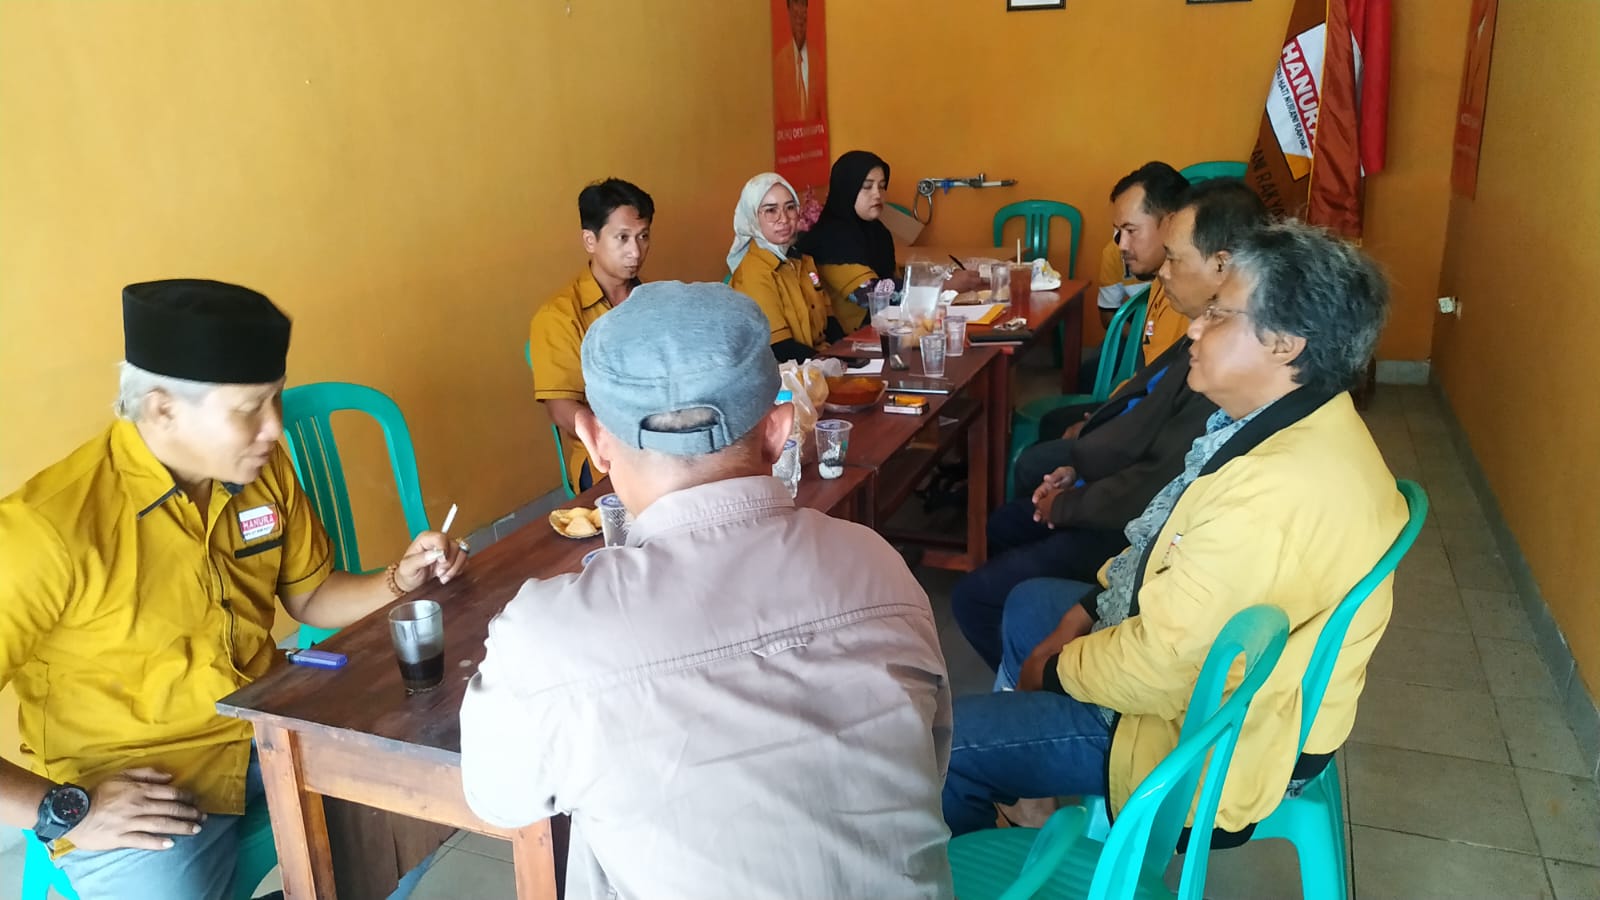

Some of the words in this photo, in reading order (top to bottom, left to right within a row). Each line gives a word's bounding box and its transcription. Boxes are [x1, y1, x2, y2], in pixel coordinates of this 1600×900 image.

[1278, 78, 1289, 97] HATI
[1283, 94, 1299, 124] NURANI
[243, 515, 274, 530] HANURA
